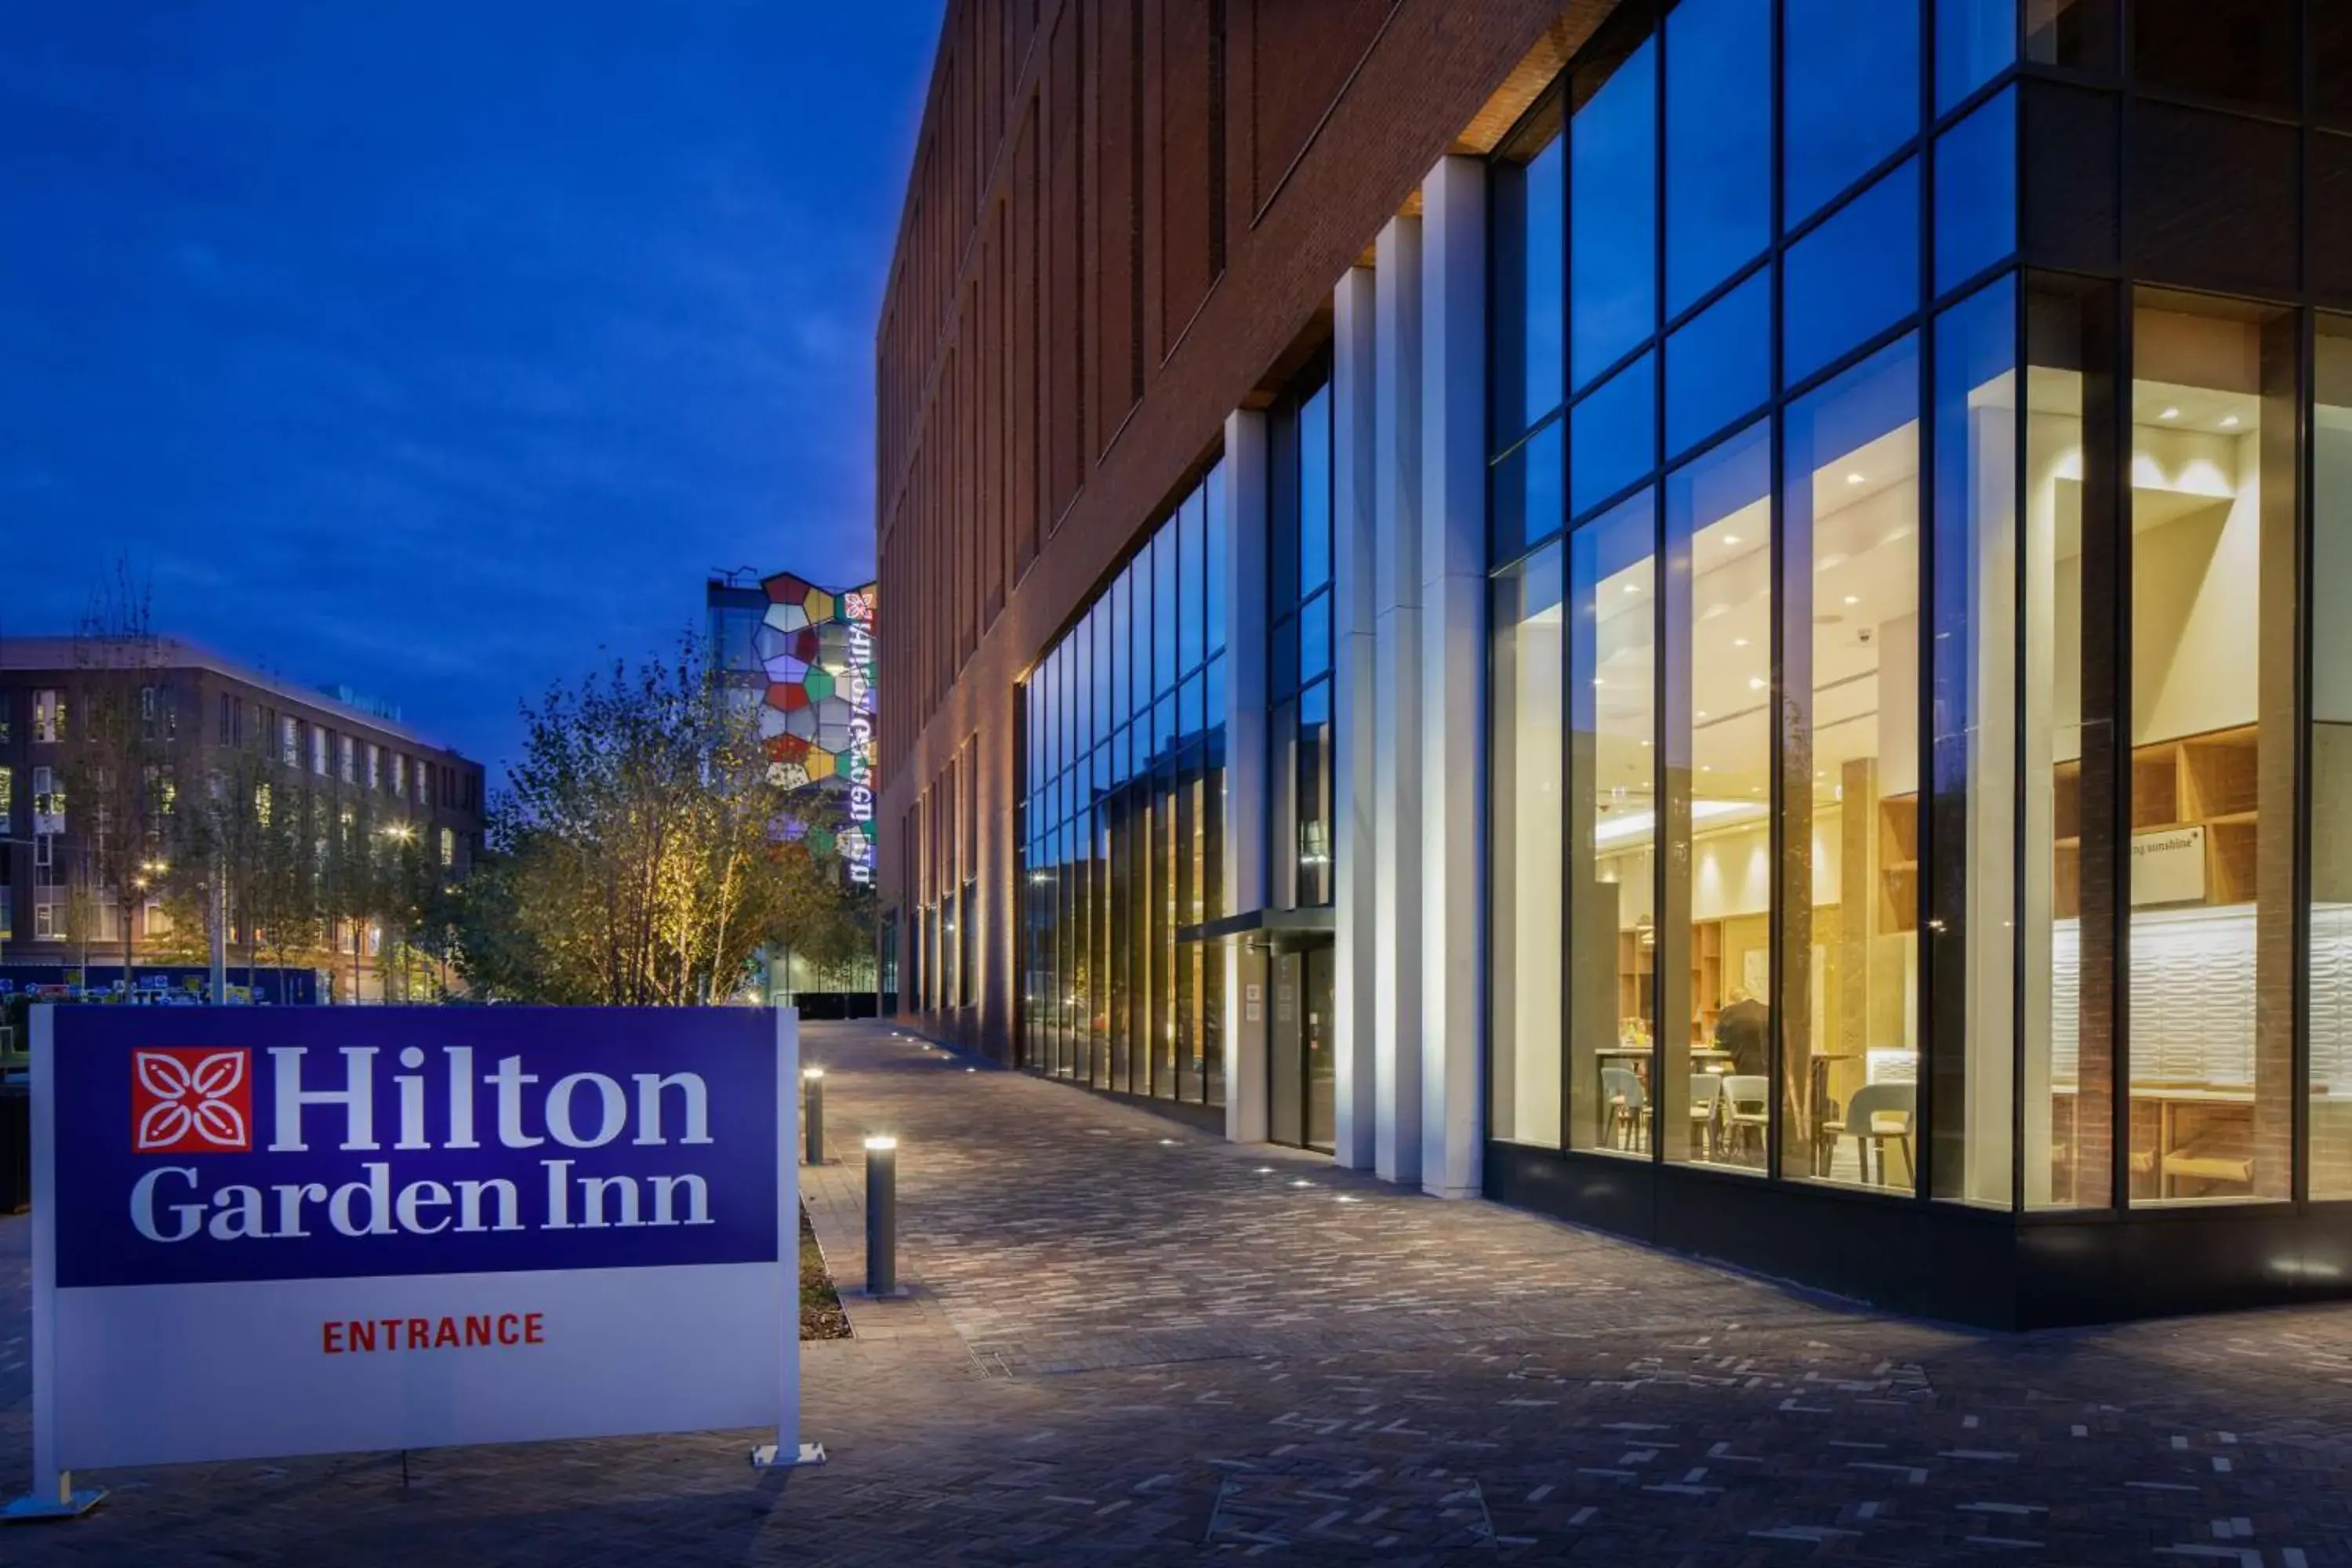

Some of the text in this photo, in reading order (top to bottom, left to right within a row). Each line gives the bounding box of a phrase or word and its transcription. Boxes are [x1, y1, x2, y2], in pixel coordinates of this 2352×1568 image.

[267, 1046, 714, 1152] Hilton
[130, 1160, 715, 1243] Garden Inn
[322, 1312, 544, 1354] ENTRANCE
